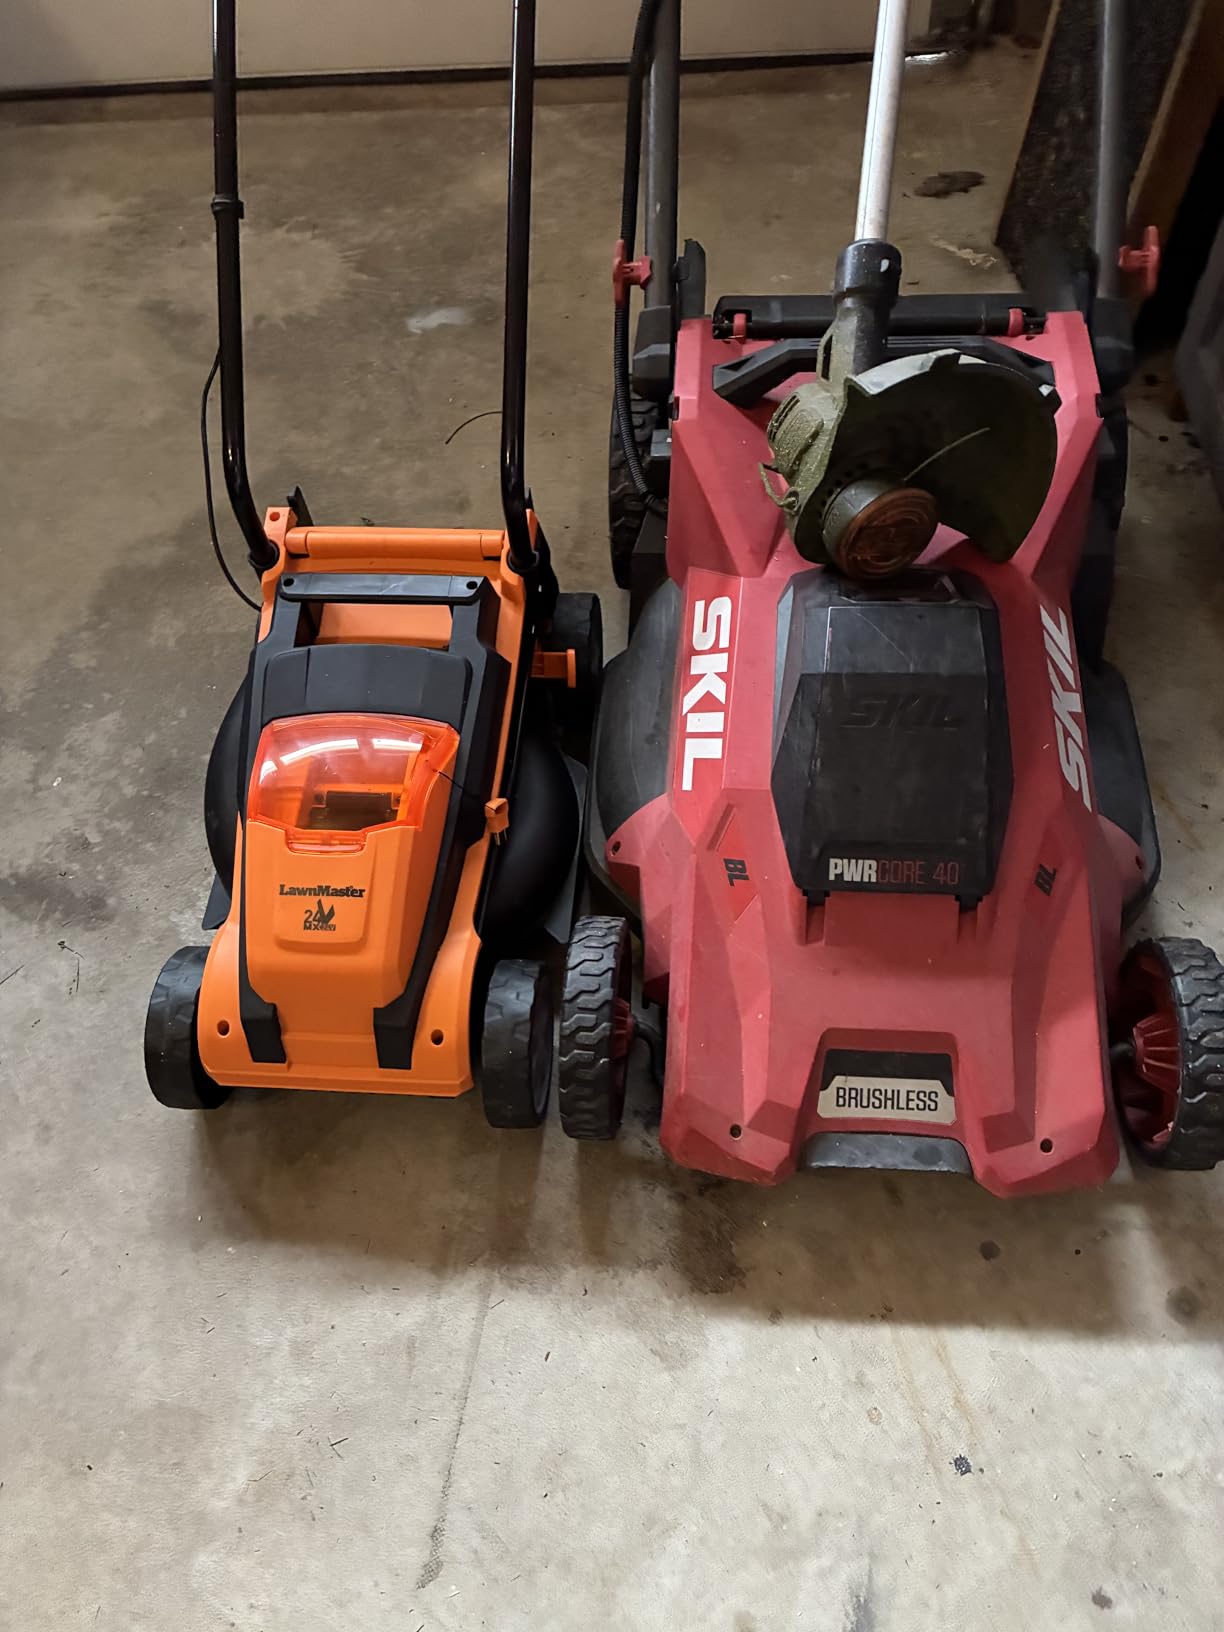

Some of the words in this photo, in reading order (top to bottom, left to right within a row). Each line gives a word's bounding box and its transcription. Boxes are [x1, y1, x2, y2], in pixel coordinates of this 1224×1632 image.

[682, 596, 732, 791] SKIL
[1040, 604, 1092, 813] SKIL
[723, 858, 750, 887] BL
[828, 857, 928, 884] PWRCORE
[932, 862, 959, 885] 40
[279, 884, 366, 898] LawnMaster
[835, 1086, 939, 1112] BRUSHLESS
